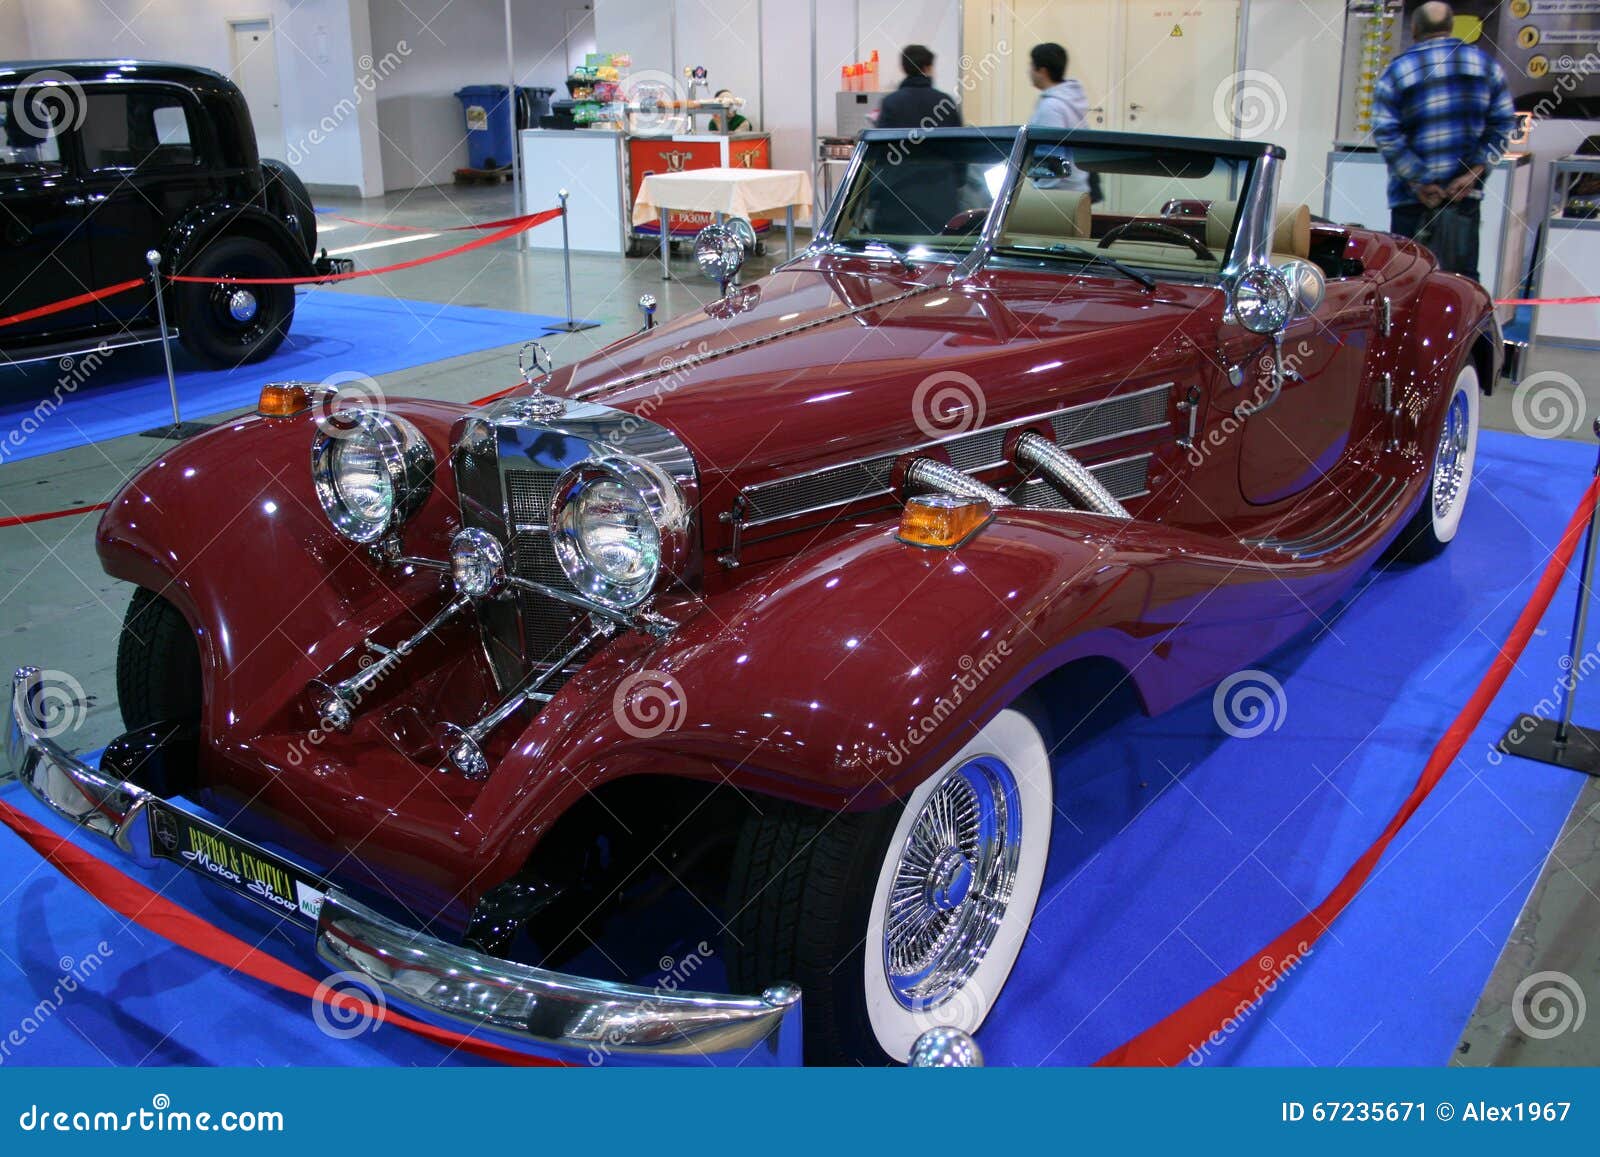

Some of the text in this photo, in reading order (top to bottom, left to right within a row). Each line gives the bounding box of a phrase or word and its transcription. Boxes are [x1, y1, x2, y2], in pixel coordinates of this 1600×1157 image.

[1530, 61, 1546, 72] UV
[182, 850, 298, 911] Motor Show
[189, 826, 293, 900] RETRO & EXOTICA
